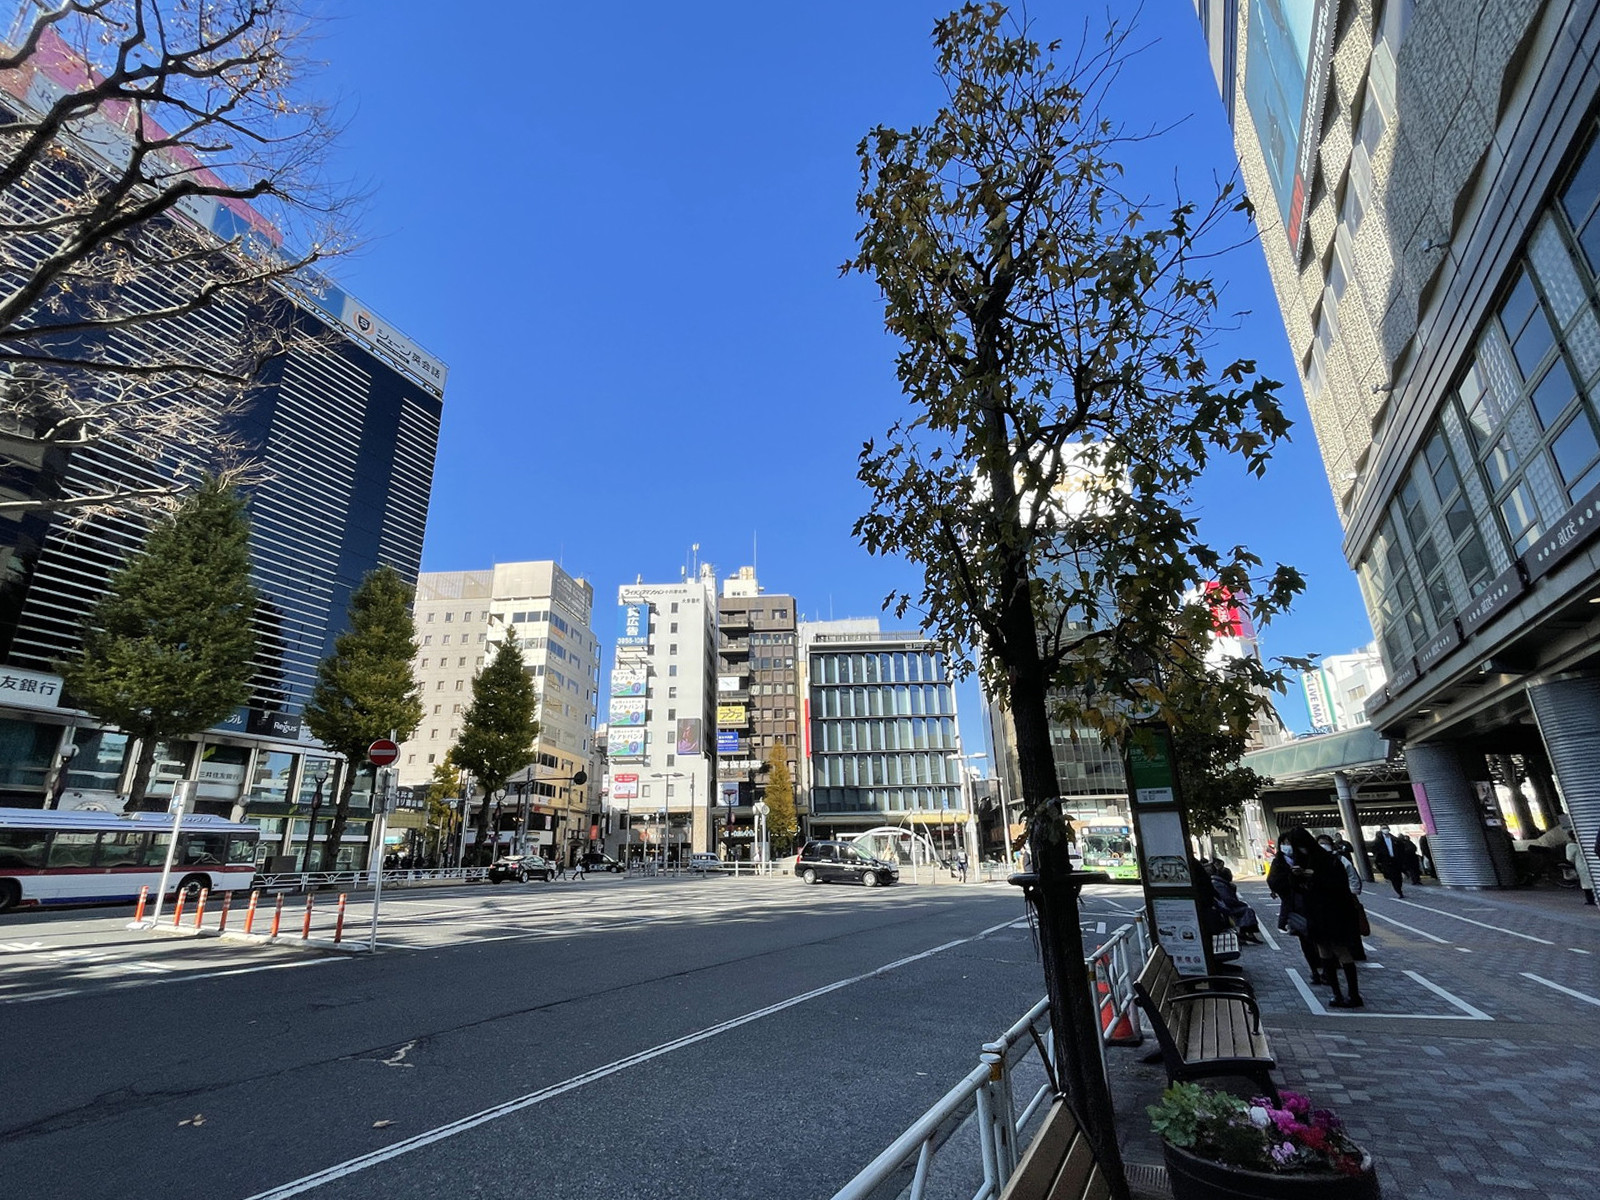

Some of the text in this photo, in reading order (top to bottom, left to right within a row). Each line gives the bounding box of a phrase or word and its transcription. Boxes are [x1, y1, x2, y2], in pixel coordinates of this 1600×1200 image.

[376, 328, 441, 379] ジェーン英会話
[0, 675, 57, 696] 友銀行
[1312, 703, 1324, 724] MAX
[273, 721, 298, 733] Regus
